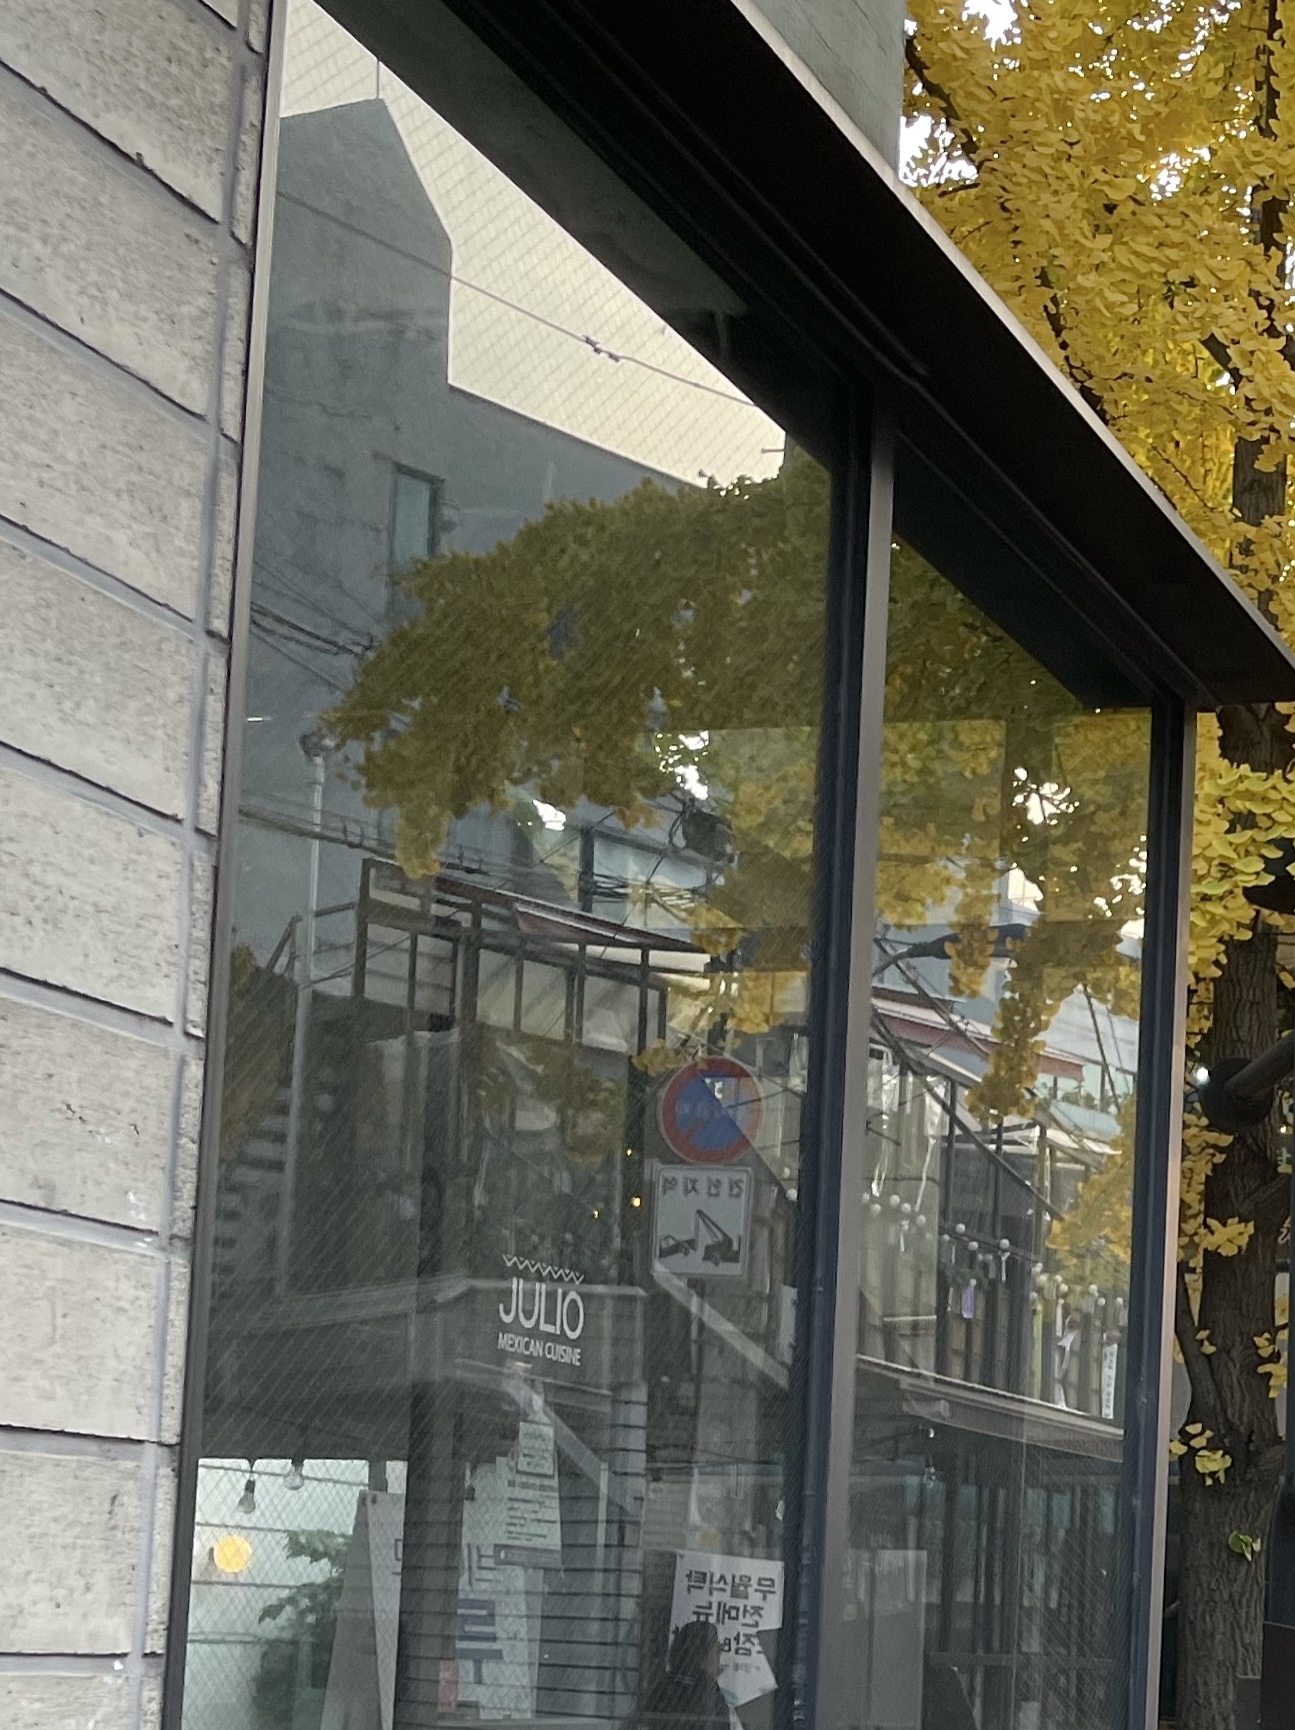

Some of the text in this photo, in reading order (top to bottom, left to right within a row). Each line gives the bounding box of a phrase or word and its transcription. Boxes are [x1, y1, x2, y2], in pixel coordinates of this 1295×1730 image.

[499, 1277, 584, 1340] JULIO
[497, 1331, 581, 1367] MEXICAN CUISINE
